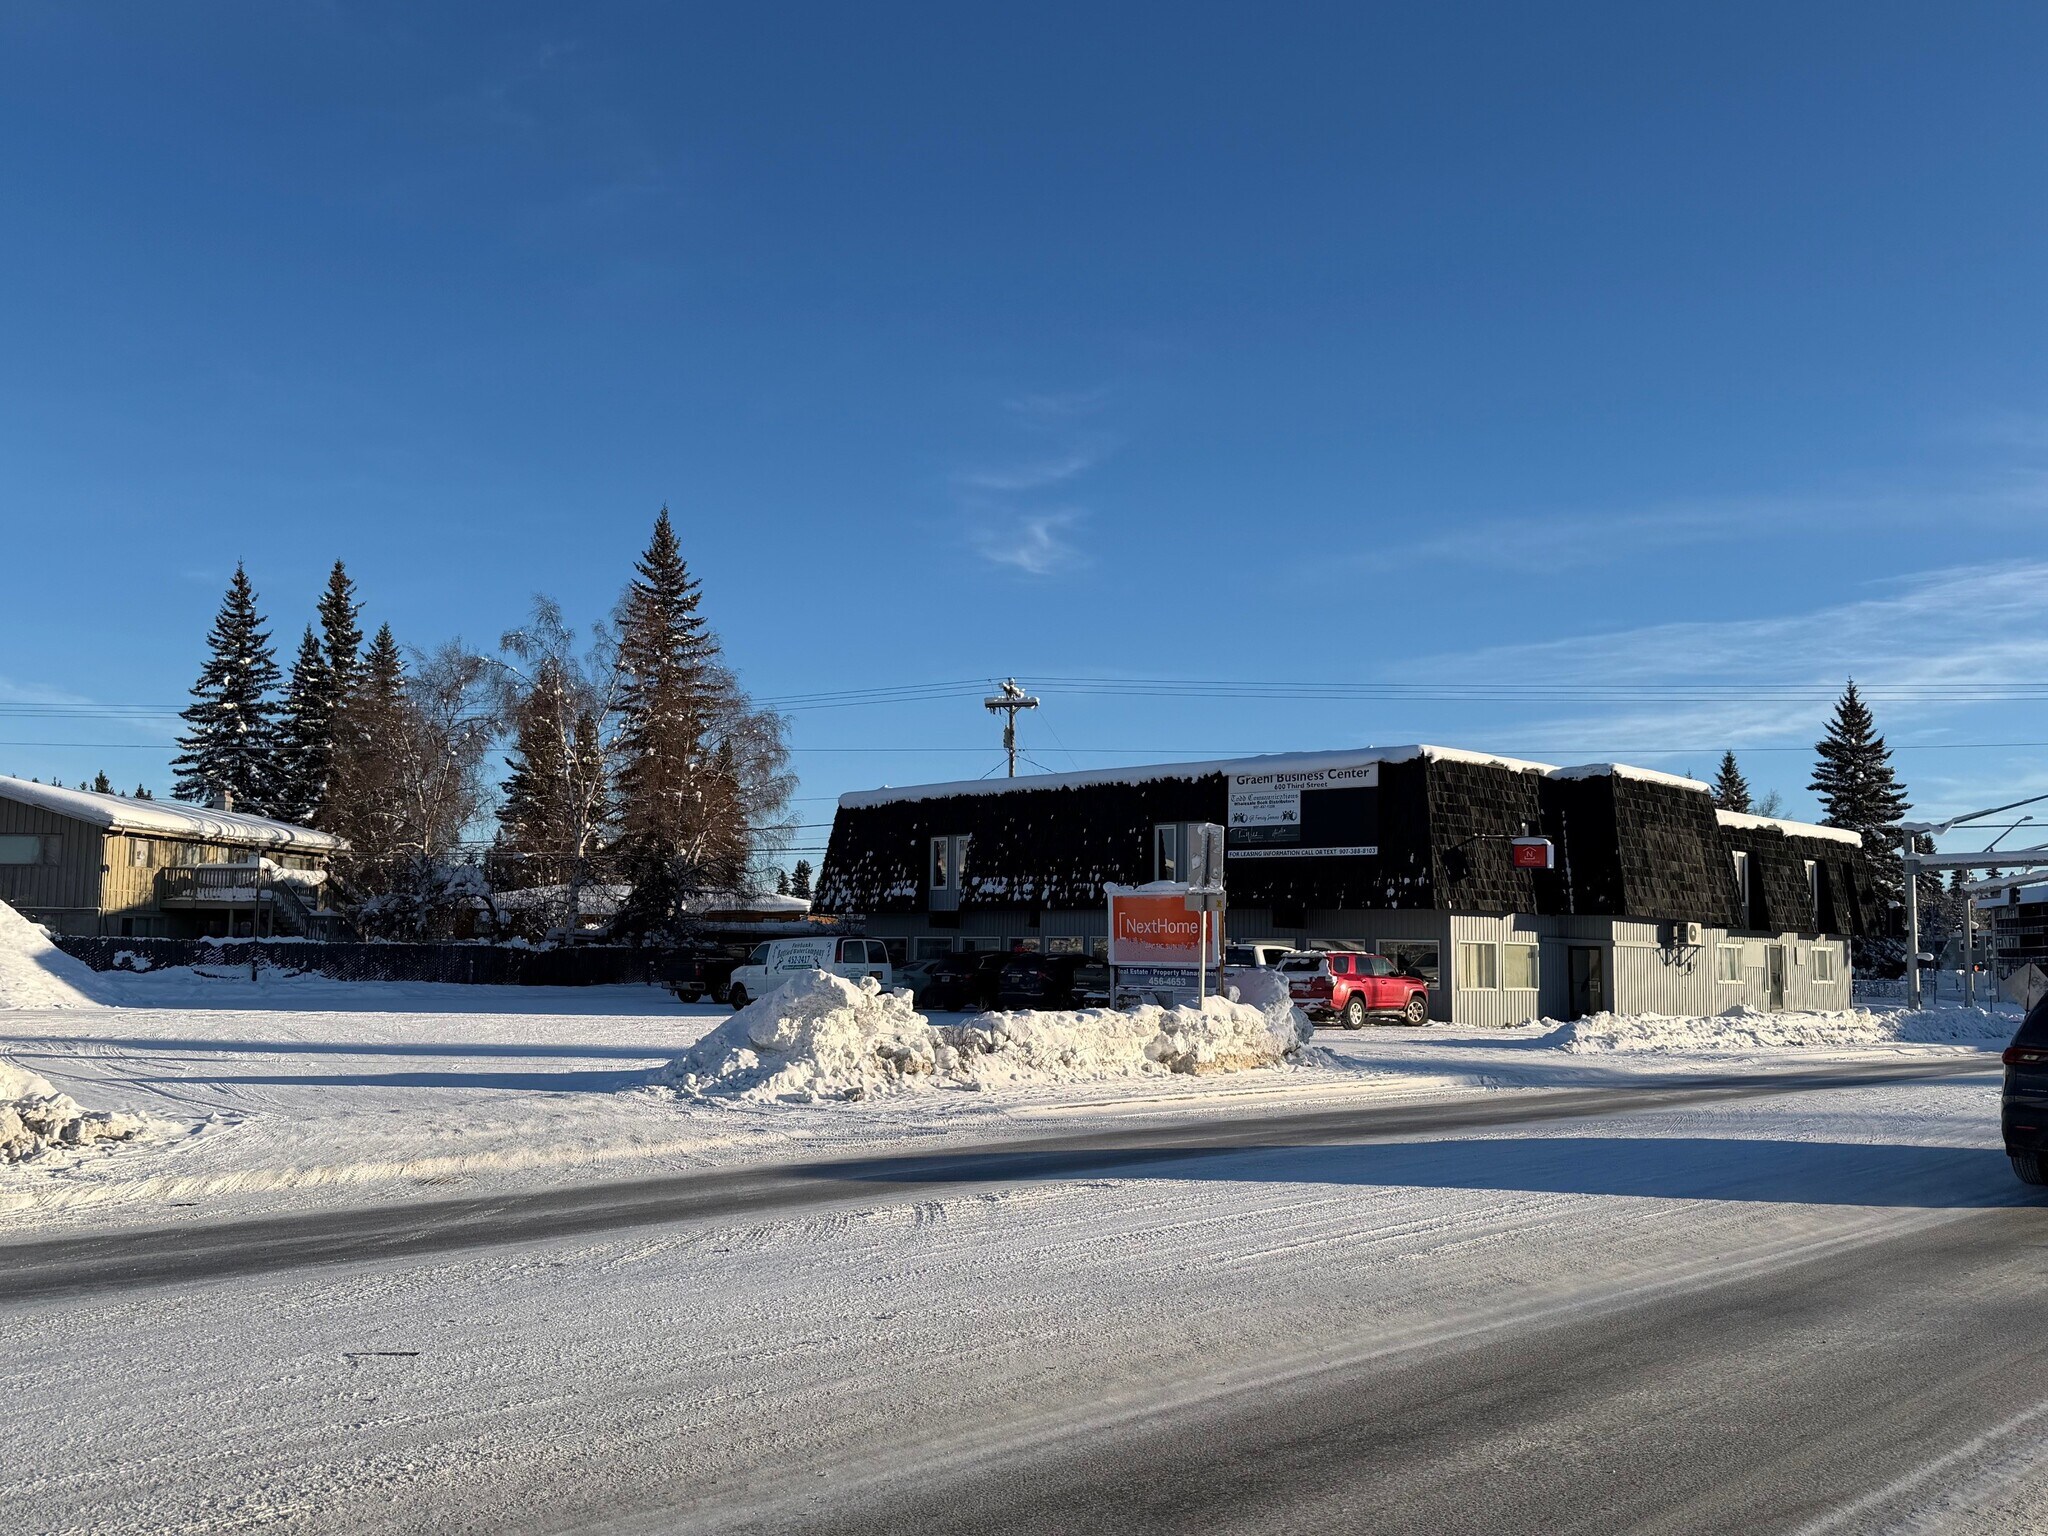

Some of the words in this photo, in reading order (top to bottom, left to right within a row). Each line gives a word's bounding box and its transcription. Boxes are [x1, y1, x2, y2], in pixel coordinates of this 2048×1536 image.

[1276, 772, 1324, 783] Business
[1328, 768, 1370, 779] Center
[1126, 918, 1199, 934] NextHome
[1153, 969, 1180, 977] Property
[1148, 977, 1186, 986] 456-4653
